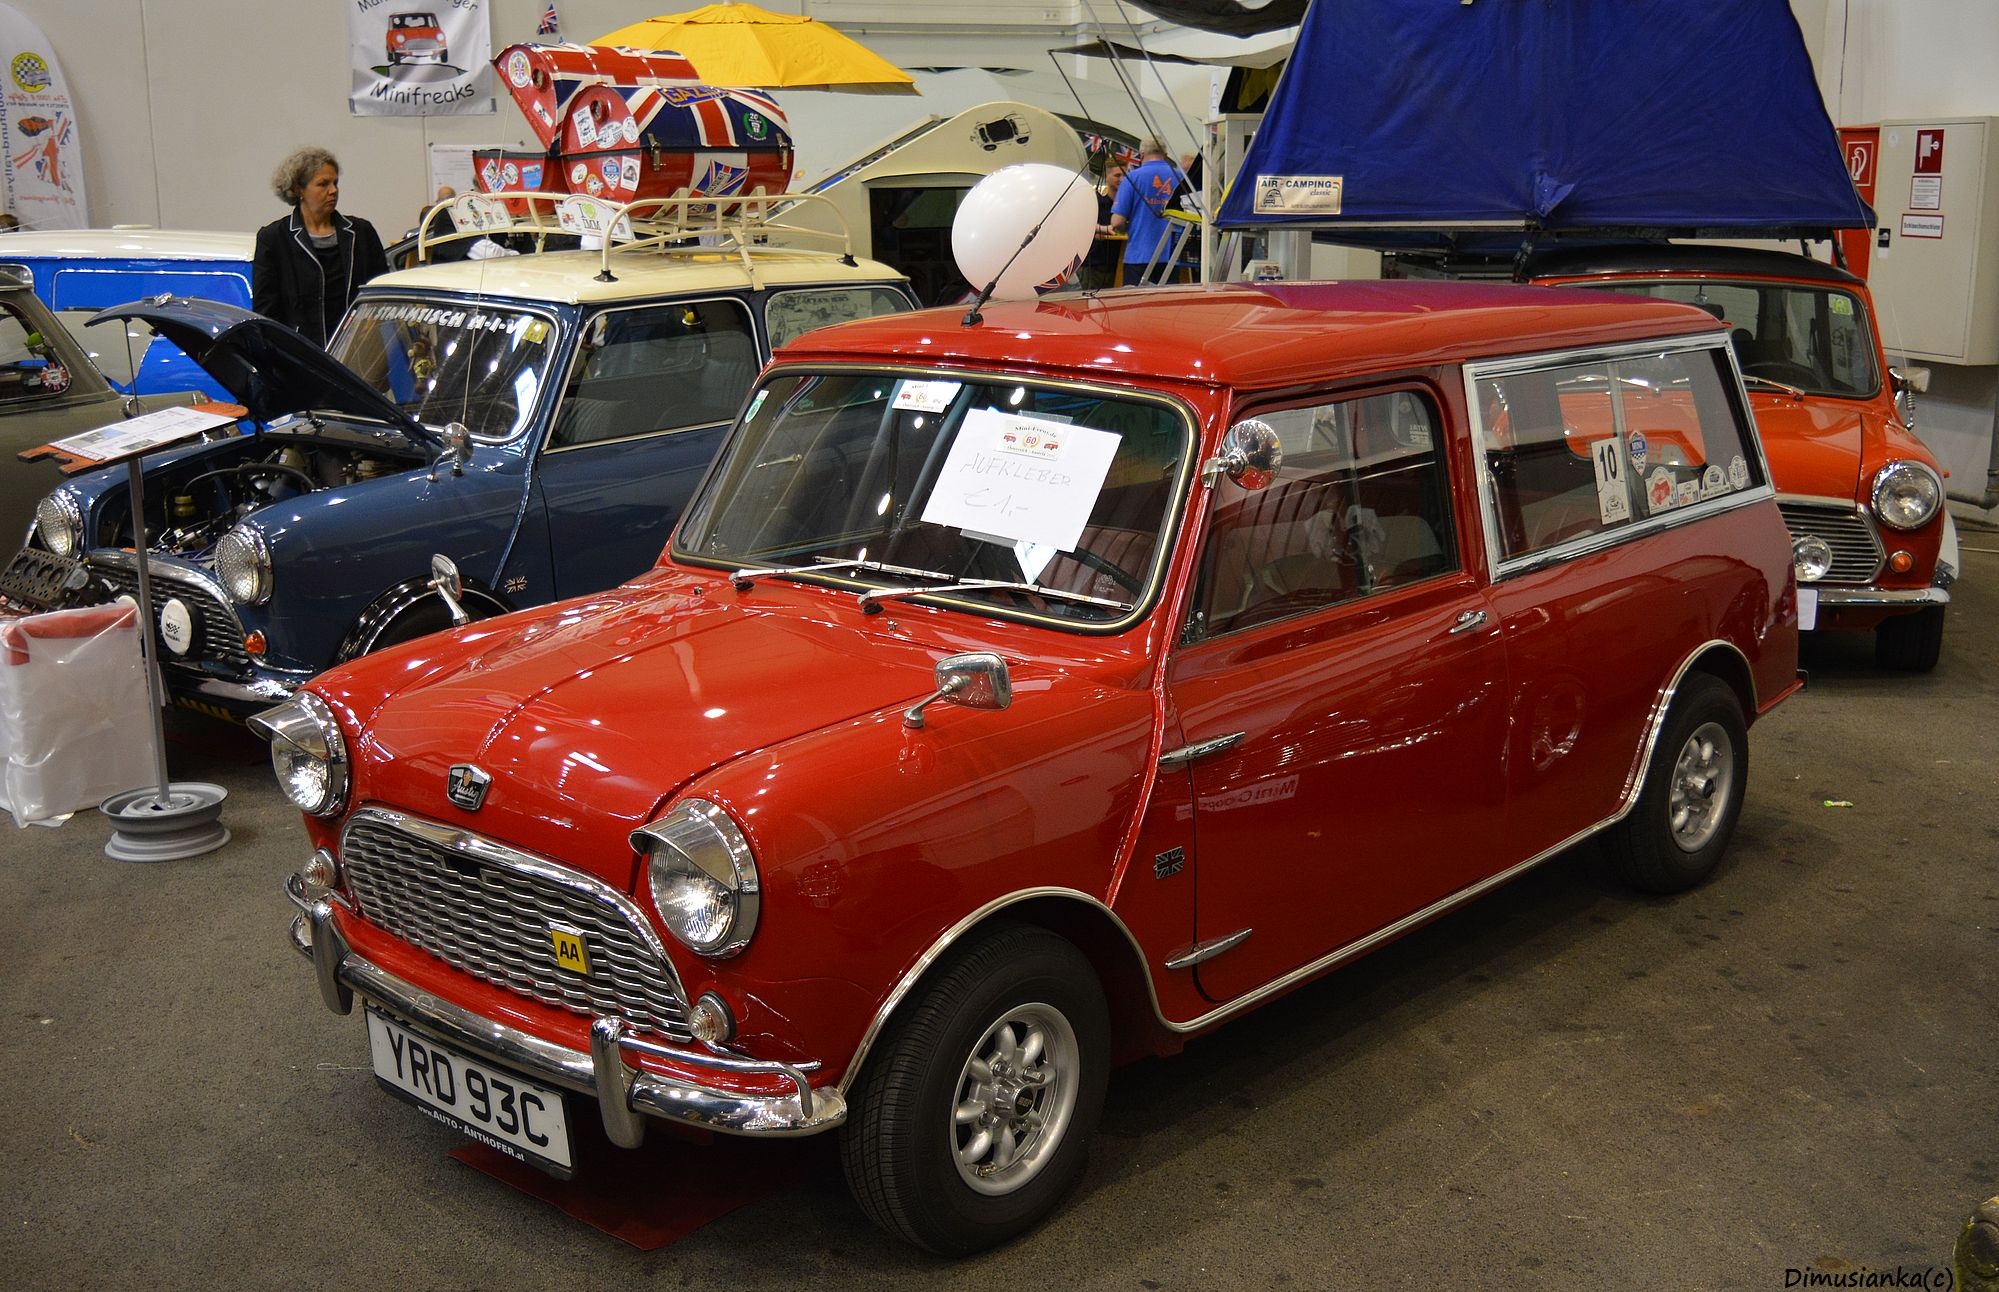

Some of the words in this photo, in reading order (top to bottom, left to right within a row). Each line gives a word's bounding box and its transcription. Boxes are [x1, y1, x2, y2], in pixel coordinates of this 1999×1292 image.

[370, 82, 475, 105] Minifreaks
[1261, 180, 1278, 188] AIR
[1285, 180, 1332, 188] CAMPING
[374, 306, 467, 328] STAMMTISCH
[1026, 436, 1037, 445] 60
[960, 451, 1072, 487] AUFKLEBER
[1599, 444, 1617, 482] 10
[560, 940, 580, 962] AA
[386, 1026, 456, 1106] YRD
[465, 1068, 549, 1148] 93C
